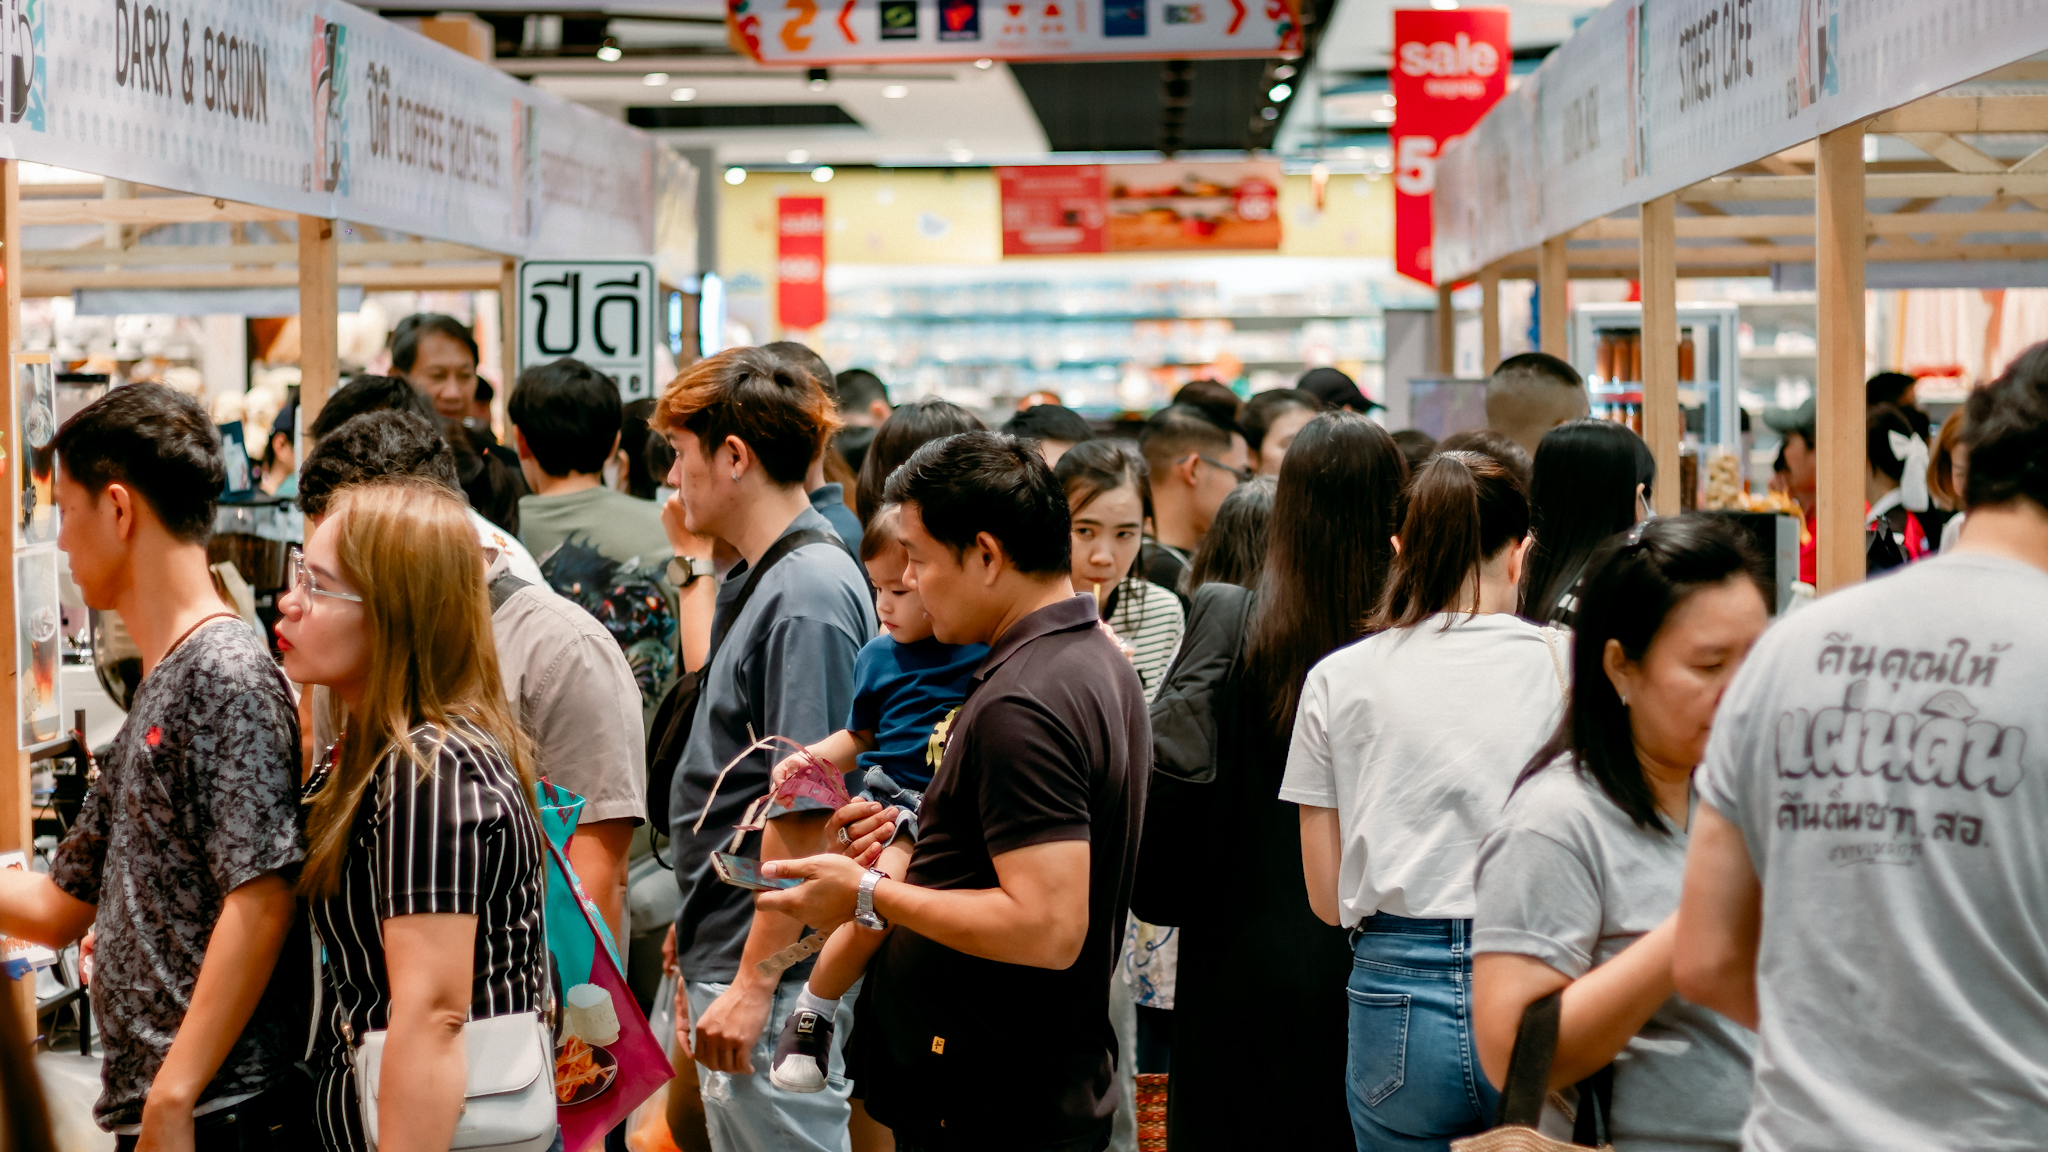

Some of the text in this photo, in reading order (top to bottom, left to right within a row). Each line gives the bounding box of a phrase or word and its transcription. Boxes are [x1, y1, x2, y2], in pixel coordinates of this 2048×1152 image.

[116, 0, 267, 125] DARK & BROWN
[1399, 32, 1500, 77] sale
[1679, 9, 1718, 113] STREET
[397, 95, 444, 174] COFFEE
[531, 272, 641, 357] ปีดี
[1774, 678, 2027, 799] แผ่นดิน
